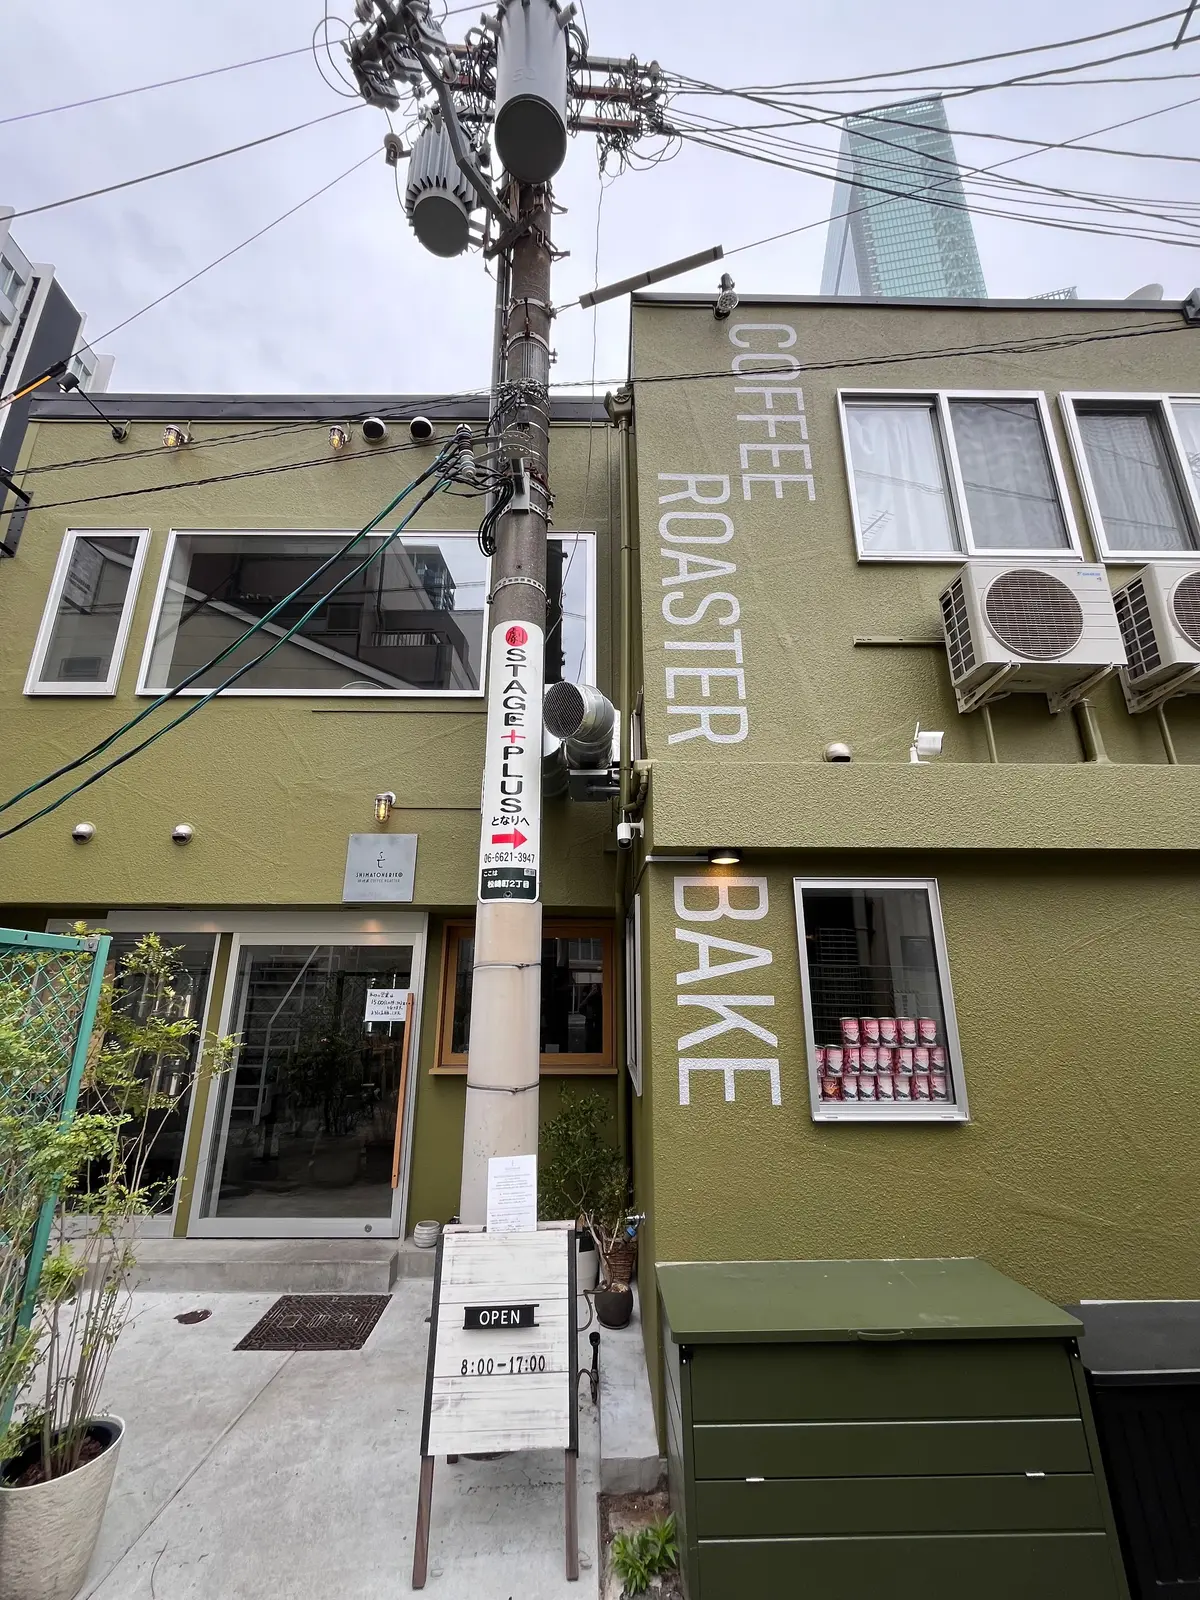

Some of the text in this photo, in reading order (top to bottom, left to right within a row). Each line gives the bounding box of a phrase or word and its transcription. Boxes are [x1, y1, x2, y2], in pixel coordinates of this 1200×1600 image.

[728, 323, 816, 500] COFFEE
[658, 473, 749, 745] ROASTER
[491, 815, 530, 827] となりへ
[483, 851, 536, 864] 06-6621-3947
[483, 869, 499, 878] ここは
[674, 877, 782, 1105] BAKE
[479, 1310, 520, 1326] OPEN
[460, 1355, 546, 1375] 8:00-17:00
